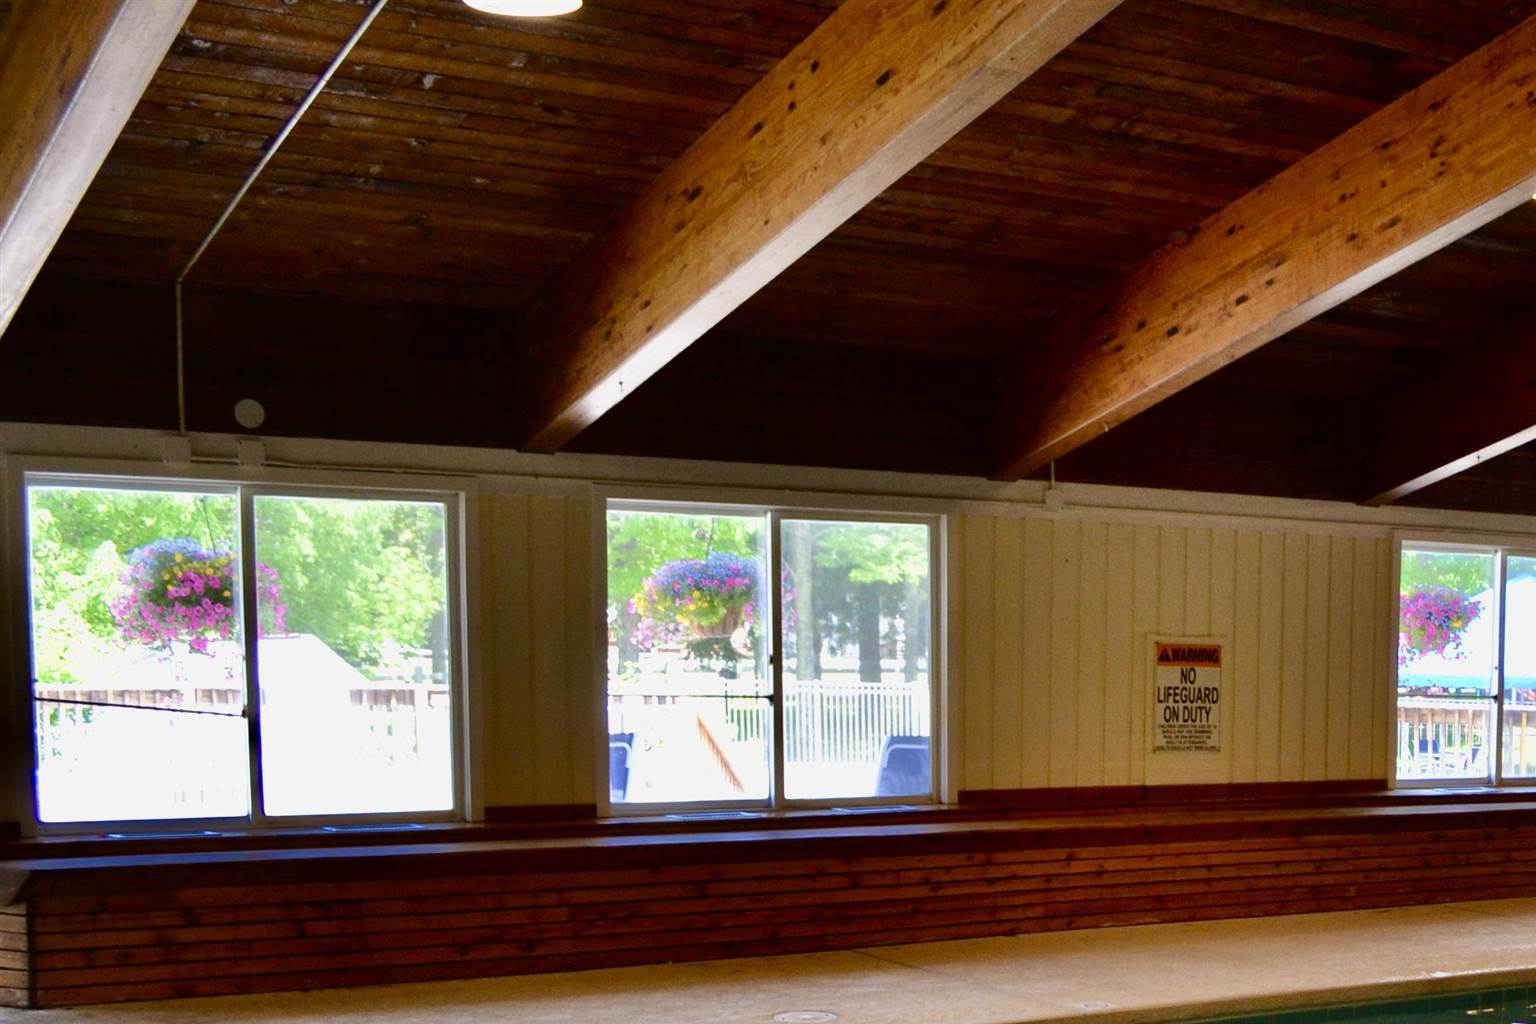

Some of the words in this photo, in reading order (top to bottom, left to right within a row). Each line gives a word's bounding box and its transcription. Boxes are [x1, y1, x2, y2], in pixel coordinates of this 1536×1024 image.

[1171, 647, 1219, 664] WARNING
[1180, 667, 1197, 685] NO
[1157, 686, 1219, 704] LIFEGUARD
[1163, 705, 1180, 723] ON
[1182, 706, 1212, 723] DUTY
